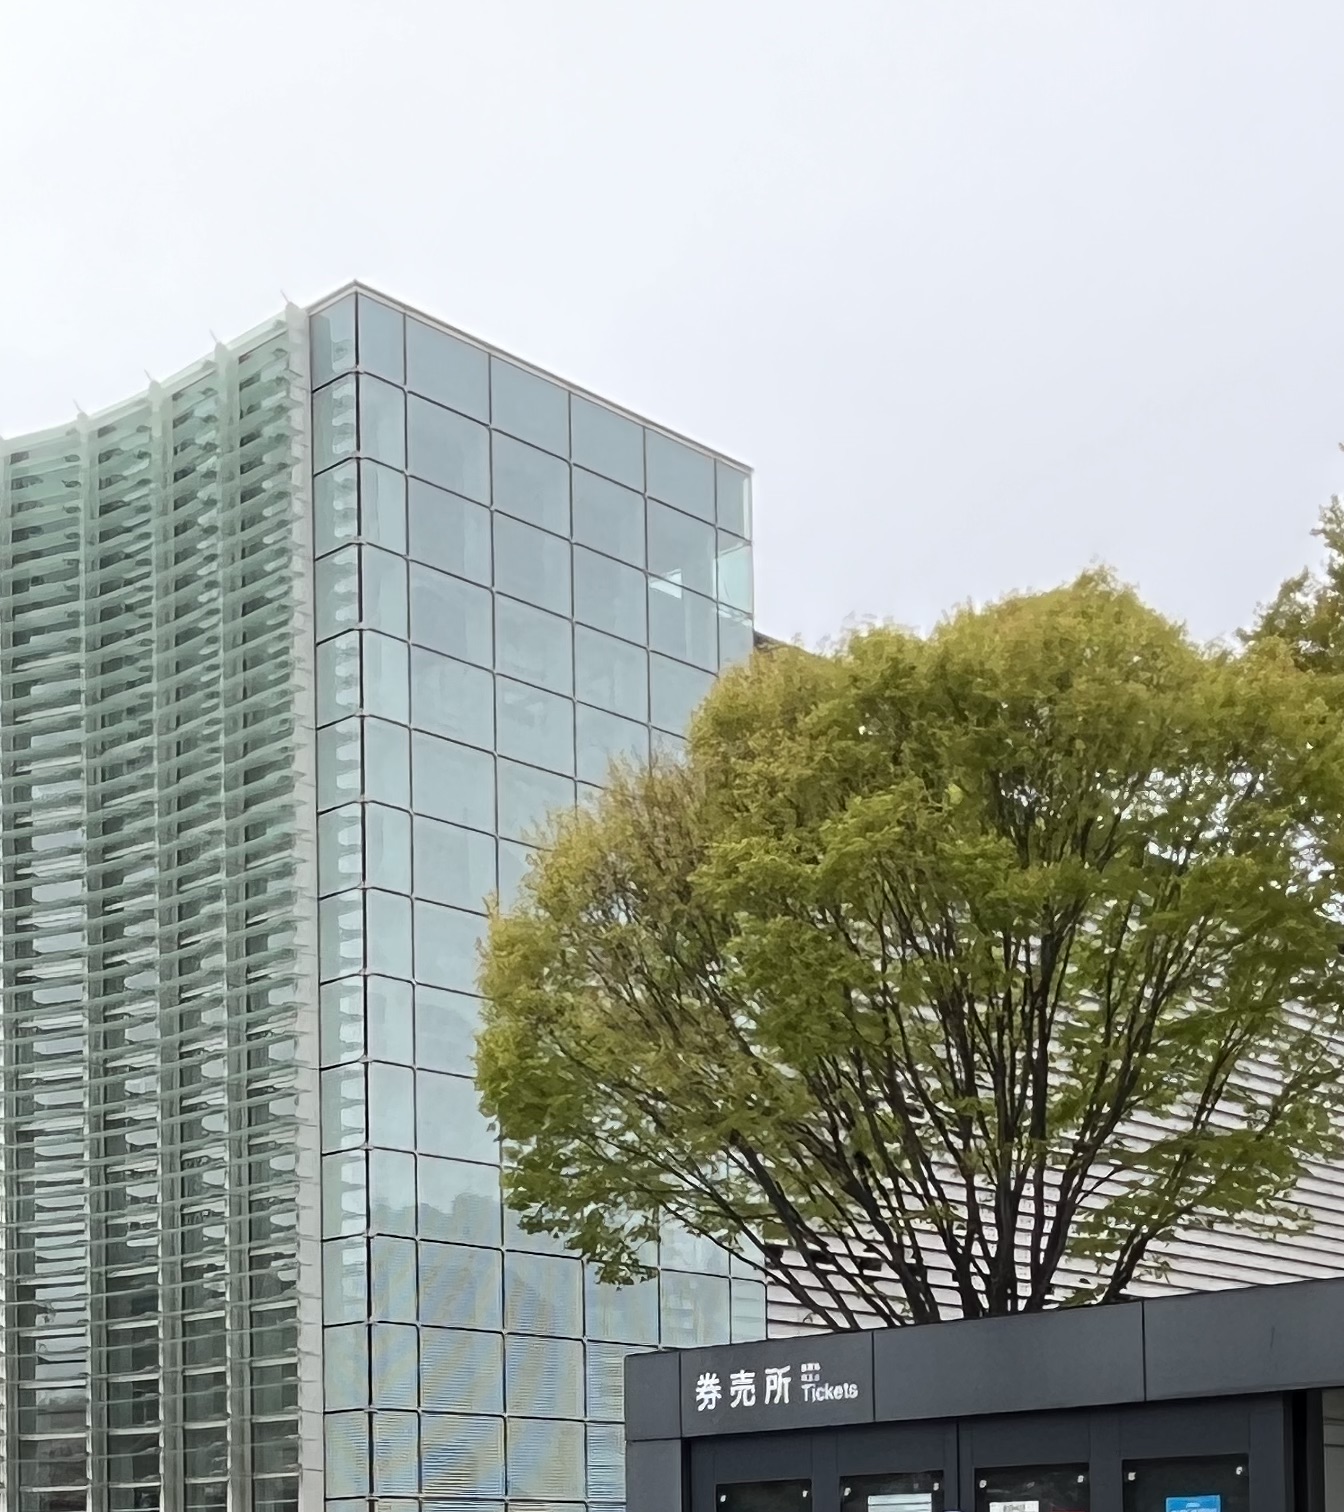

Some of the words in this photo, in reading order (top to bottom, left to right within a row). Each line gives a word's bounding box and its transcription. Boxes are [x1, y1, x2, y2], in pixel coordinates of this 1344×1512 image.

[696, 1365, 791, 1411] 券売所
[801, 1383, 858, 1402] Tickets
